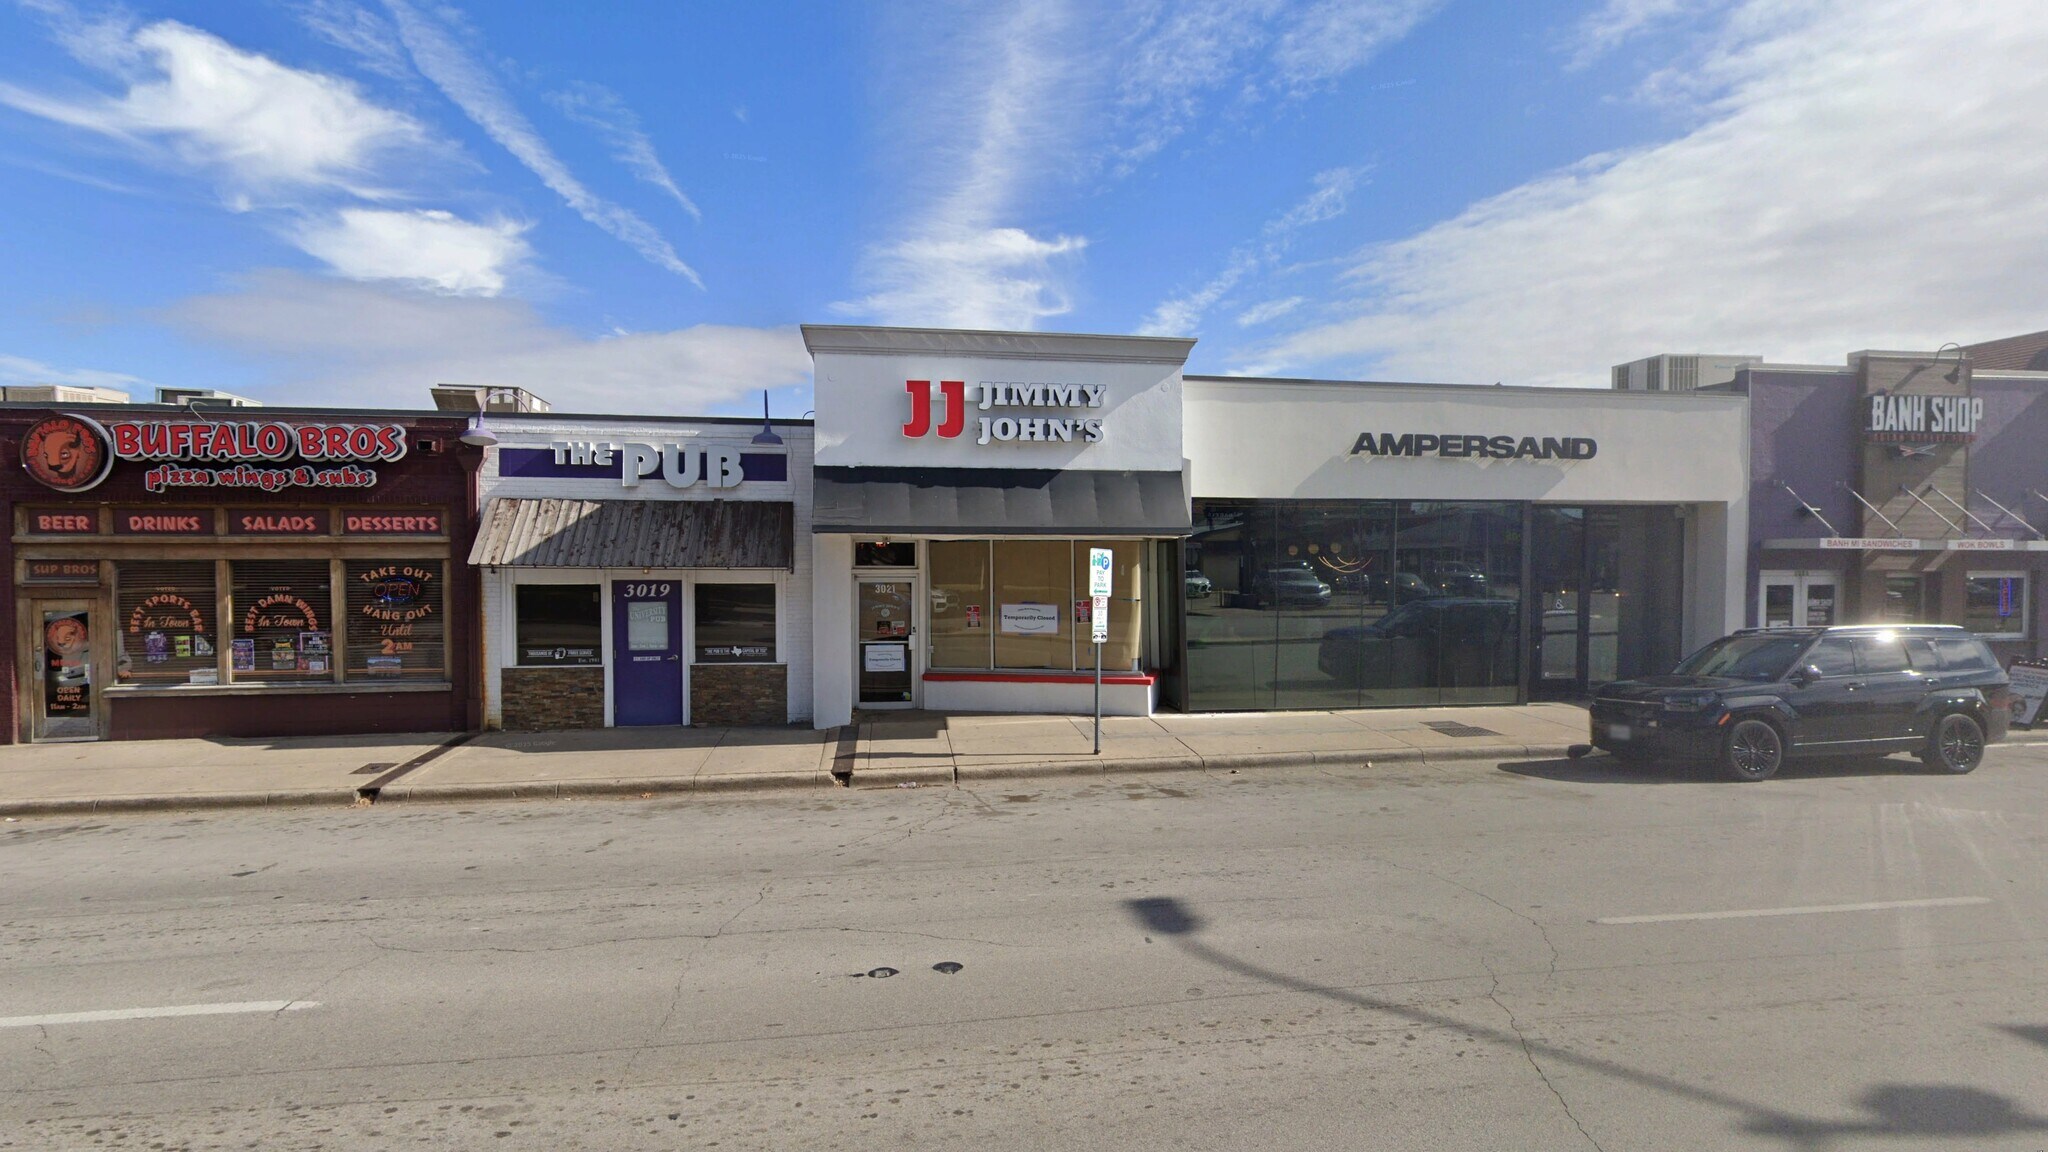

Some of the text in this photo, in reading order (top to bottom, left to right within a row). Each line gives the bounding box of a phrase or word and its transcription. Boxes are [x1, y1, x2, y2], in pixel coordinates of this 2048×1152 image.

[979, 381, 1107, 410] JIMMY
[903, 379, 965, 439] JJ
[1872, 395, 1983, 433] BANH SHOP
[977, 416, 1105, 445] JOHN'S
[112, 422, 406, 462] BUFFALO BROS
[1351, 432, 1597, 460] AMPERSAND
[551, 441, 744, 488] THE PUB
[145, 466, 376, 492] pizza wings & subs
[38, 515, 90, 531] BEER
[129, 516, 200, 531] DRINKS
[241, 516, 317, 531] SALADS
[347, 516, 440, 531] DESSERTS
[1826, 539, 1913, 549] BANH MI SANDWICHES
[1957, 541, 2006, 549] WOK BOWLS
[33, 563, 97, 575] SUP BROS
[360, 566, 433, 582] TAKE OUT
[375, 582, 420, 597] OPEN
[624, 583, 671, 597] 3019
[875, 584, 896, 593] 3021
[129, 594, 204, 633] BEST SPORTS BAR
[244, 594, 318, 632] BEST DAMN WINGS
[362, 604, 433, 620] HANG OUT
[650, 615, 666, 623] PUB
[143, 615, 190, 628] In Town
[258, 615, 305, 627] In Town
[381, 624, 413, 636] Until
[57, 686, 80, 694] OPEN
[57, 694, 82, 702] DAILY
